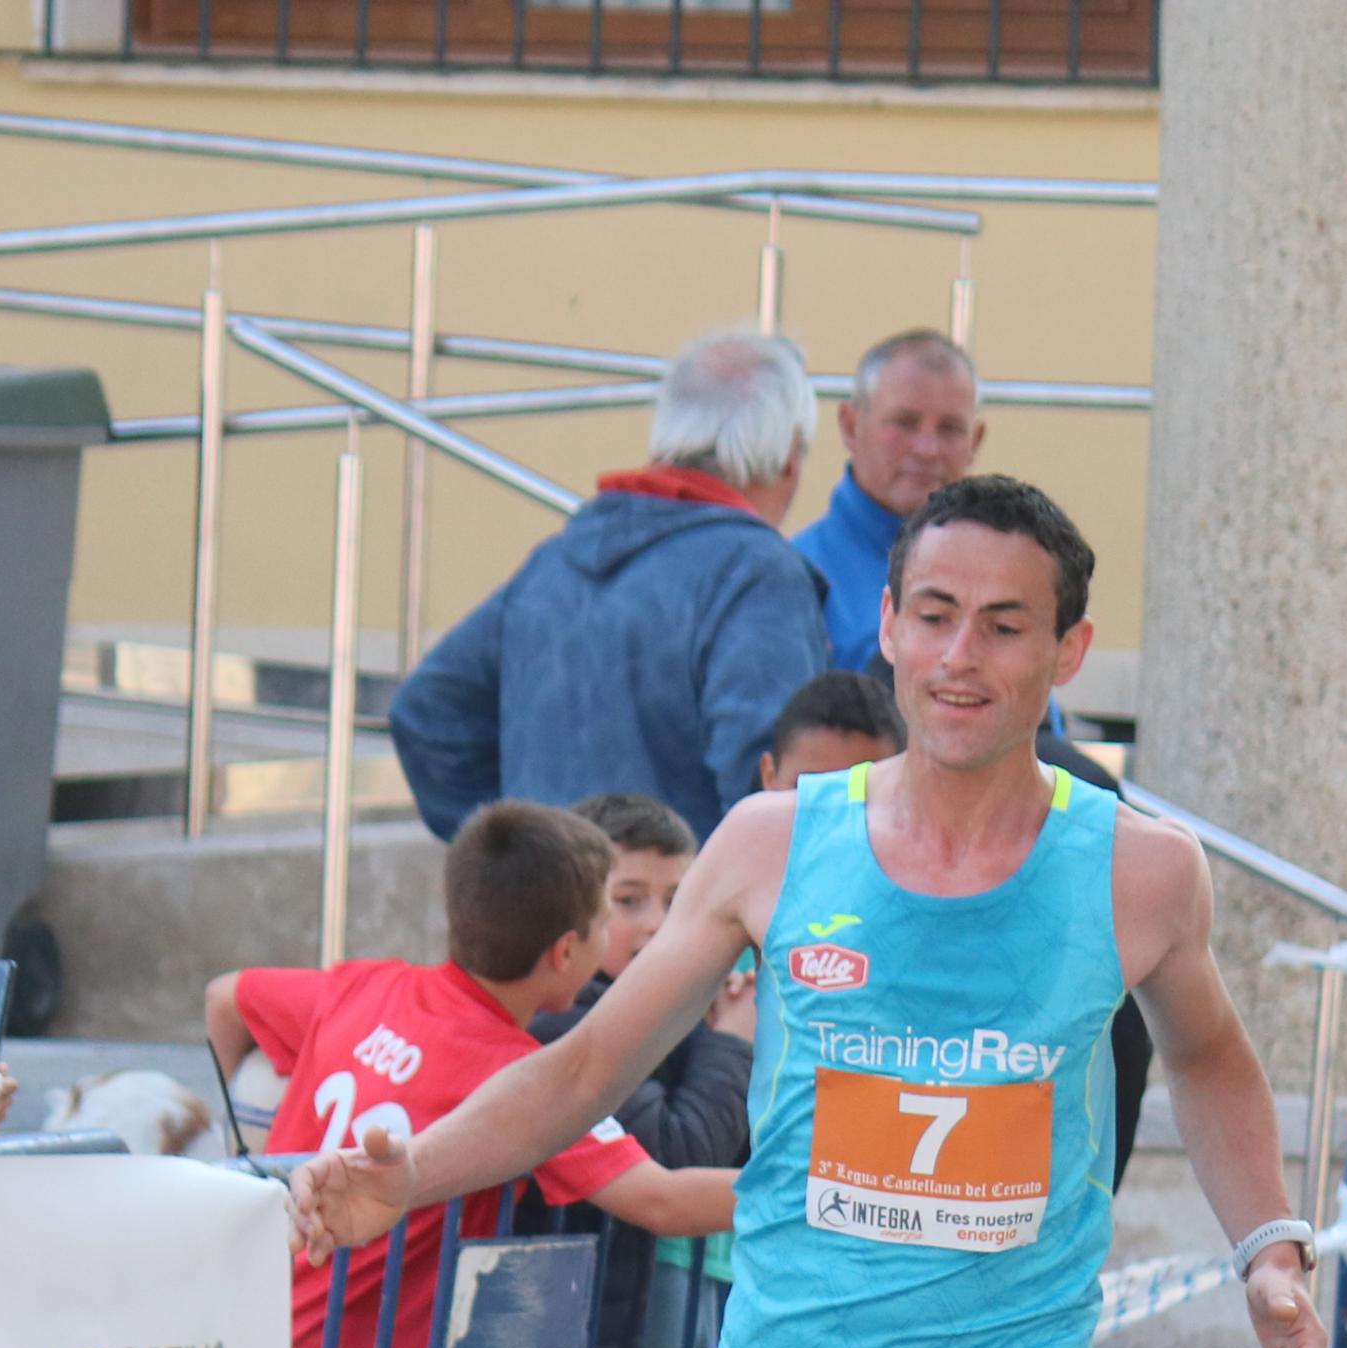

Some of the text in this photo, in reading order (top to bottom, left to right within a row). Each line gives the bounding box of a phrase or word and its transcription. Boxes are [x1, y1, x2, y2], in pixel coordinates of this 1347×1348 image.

[799, 951, 857, 982] Tello
[353, 1023, 423, 1085] ISCO
[808, 1020, 1066, 1080] TrainingRey
[898, 1092, 968, 1175] 7
[836, 1163, 878, 1186] Legua
[883, 1174, 961, 1196] Castellana
[965, 1184, 987, 1197] del
[991, 1182, 1043, 1198] Cerrato
[852, 1201, 923, 1232] INTEGRA
[936, 1210, 1034, 1227] Eres nuestra
